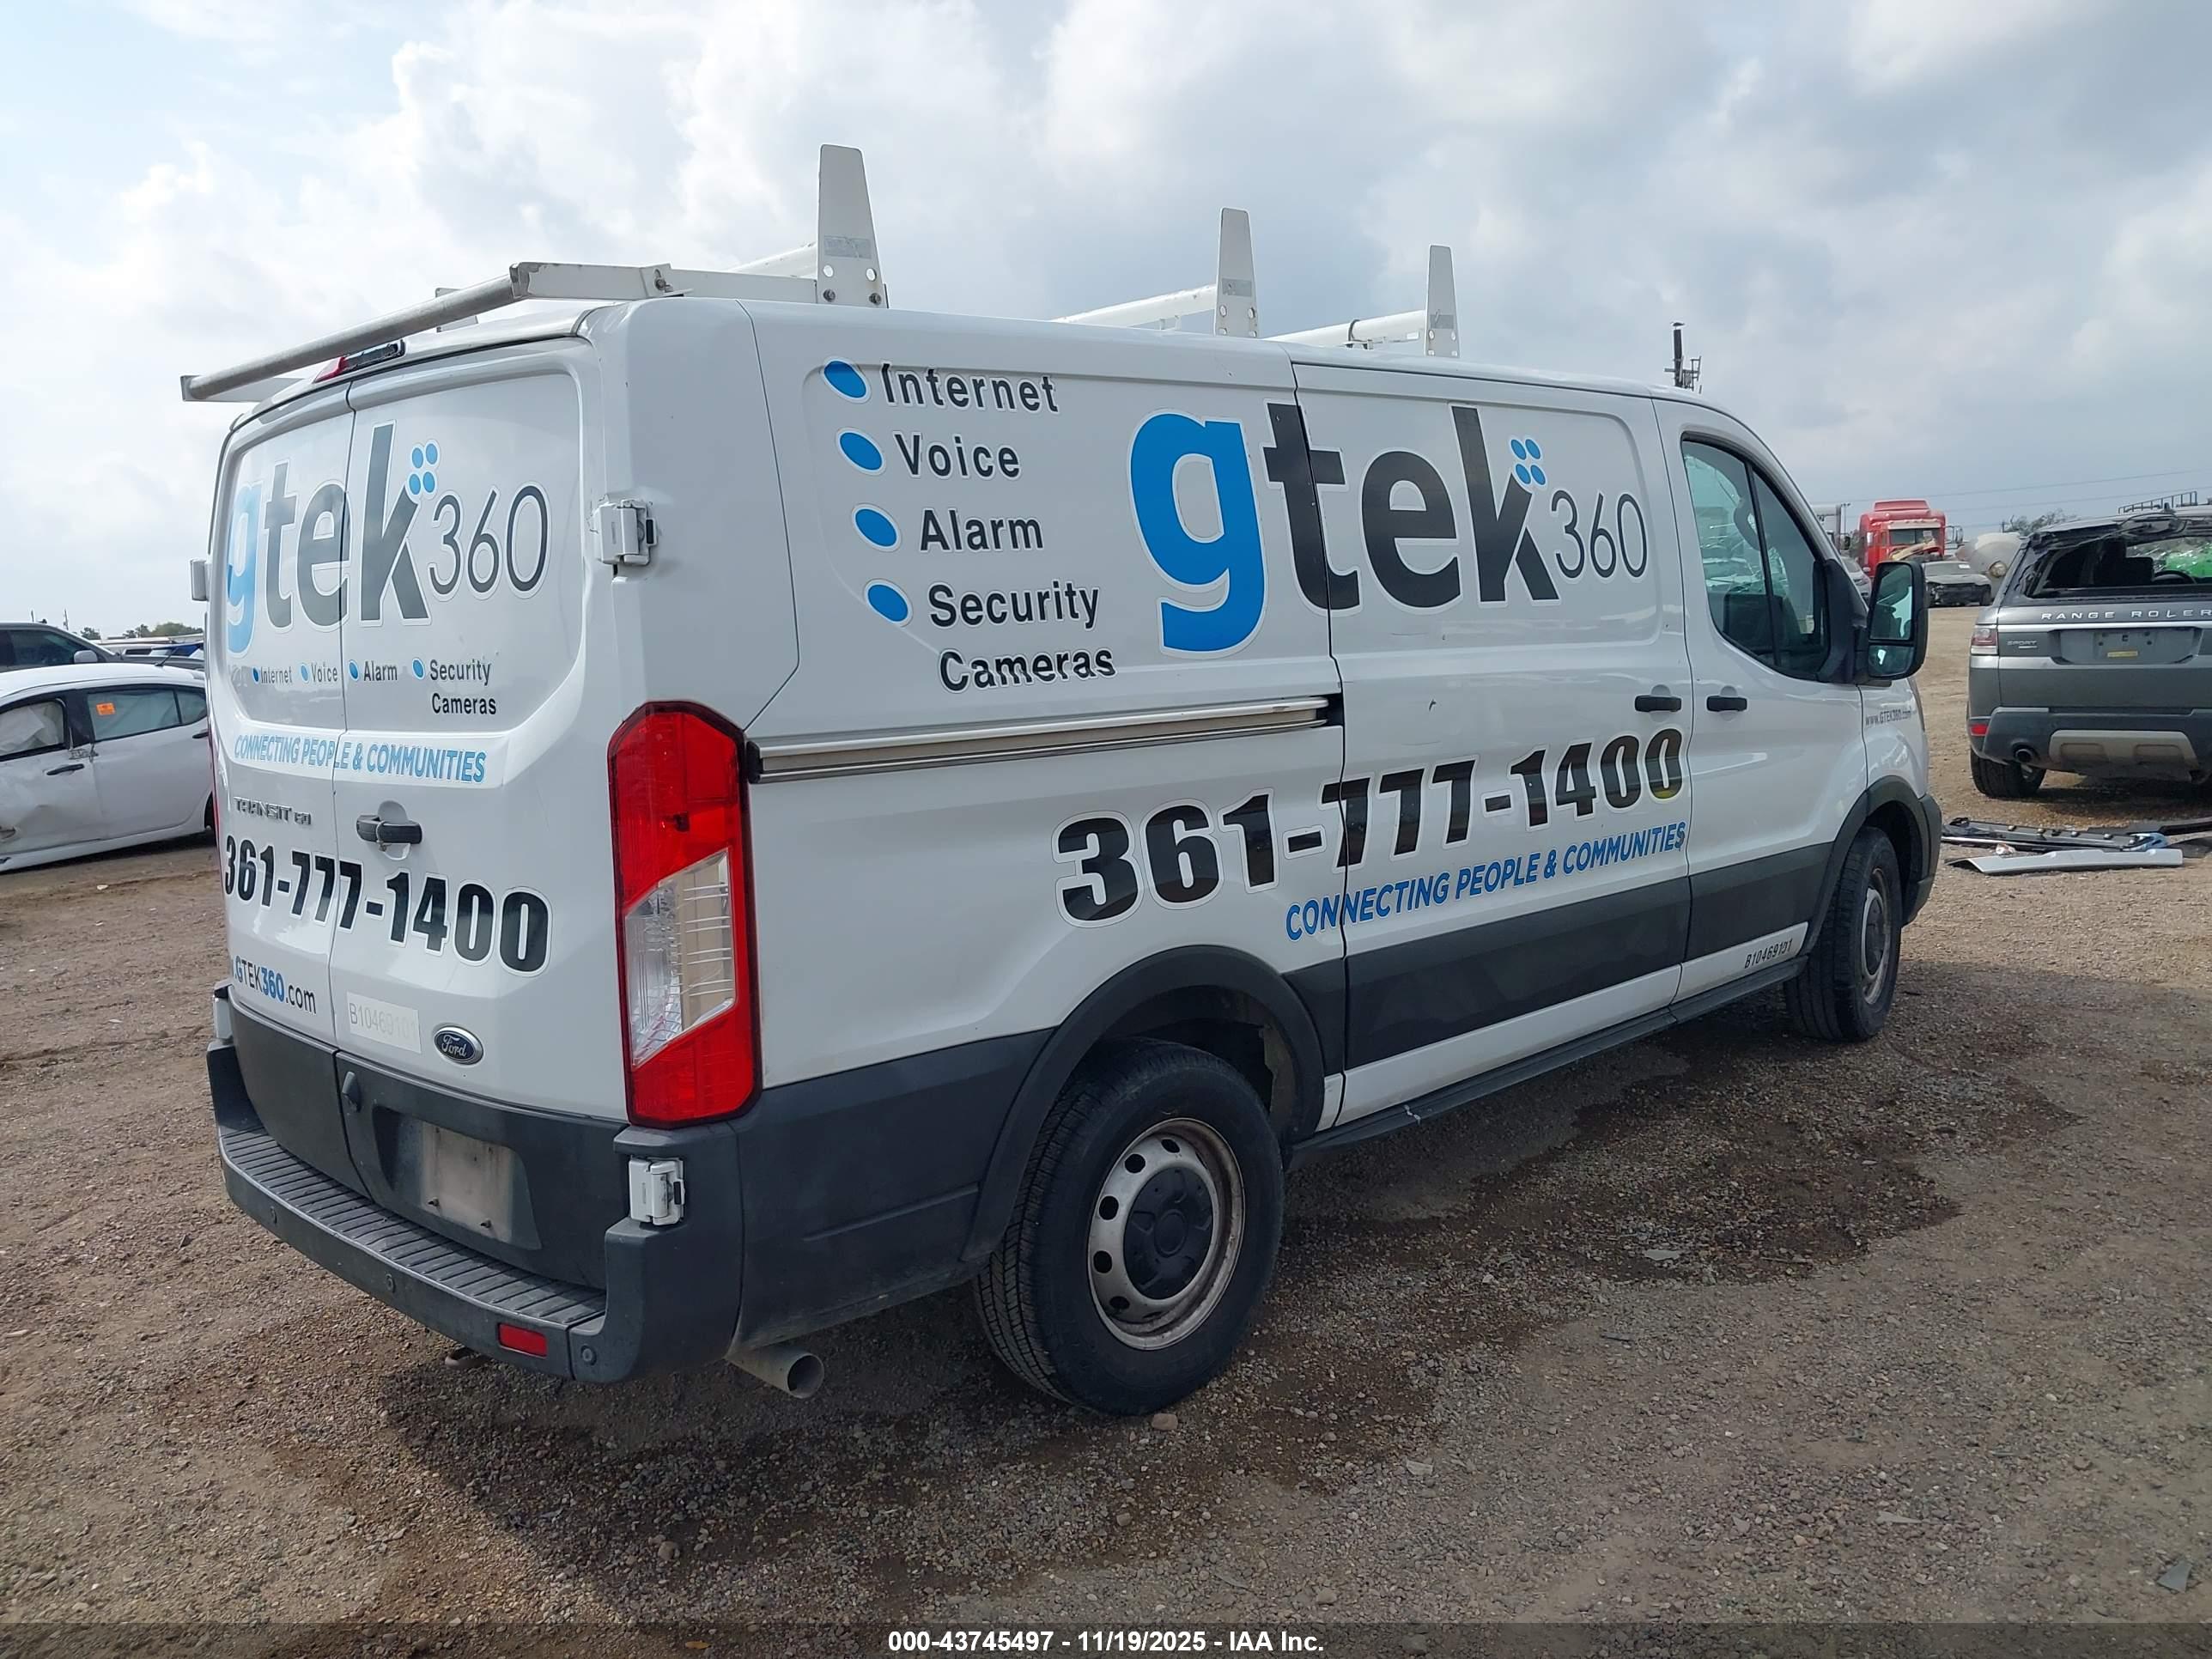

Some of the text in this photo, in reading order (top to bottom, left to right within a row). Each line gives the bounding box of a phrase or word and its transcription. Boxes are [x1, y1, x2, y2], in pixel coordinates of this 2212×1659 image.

[881, 363, 1058, 412] Internet
[895, 434, 1020, 477] Voice
[920, 510, 1043, 551] Alarm
[928, 581, 1099, 629] Security
[2041, 611, 2115, 620] RANGE
[260, 659, 491, 686] Internet Voice Alarm Security
[939, 650, 1116, 691] Cameras
[432, 694, 496, 716] Cameras
[234, 734, 486, 783] CONNECTING PEOPLE & COMMUNITIES
[1057, 728, 1682, 922] 361-777-1400
[1287, 822, 1686, 941] CONNECTING PEOPLE & COMMUNITIES
[225, 835, 550, 973] 361-777-1400
[1745, 938, 1793, 969] B10469101
[441, 1034, 467, 1057] Ford
